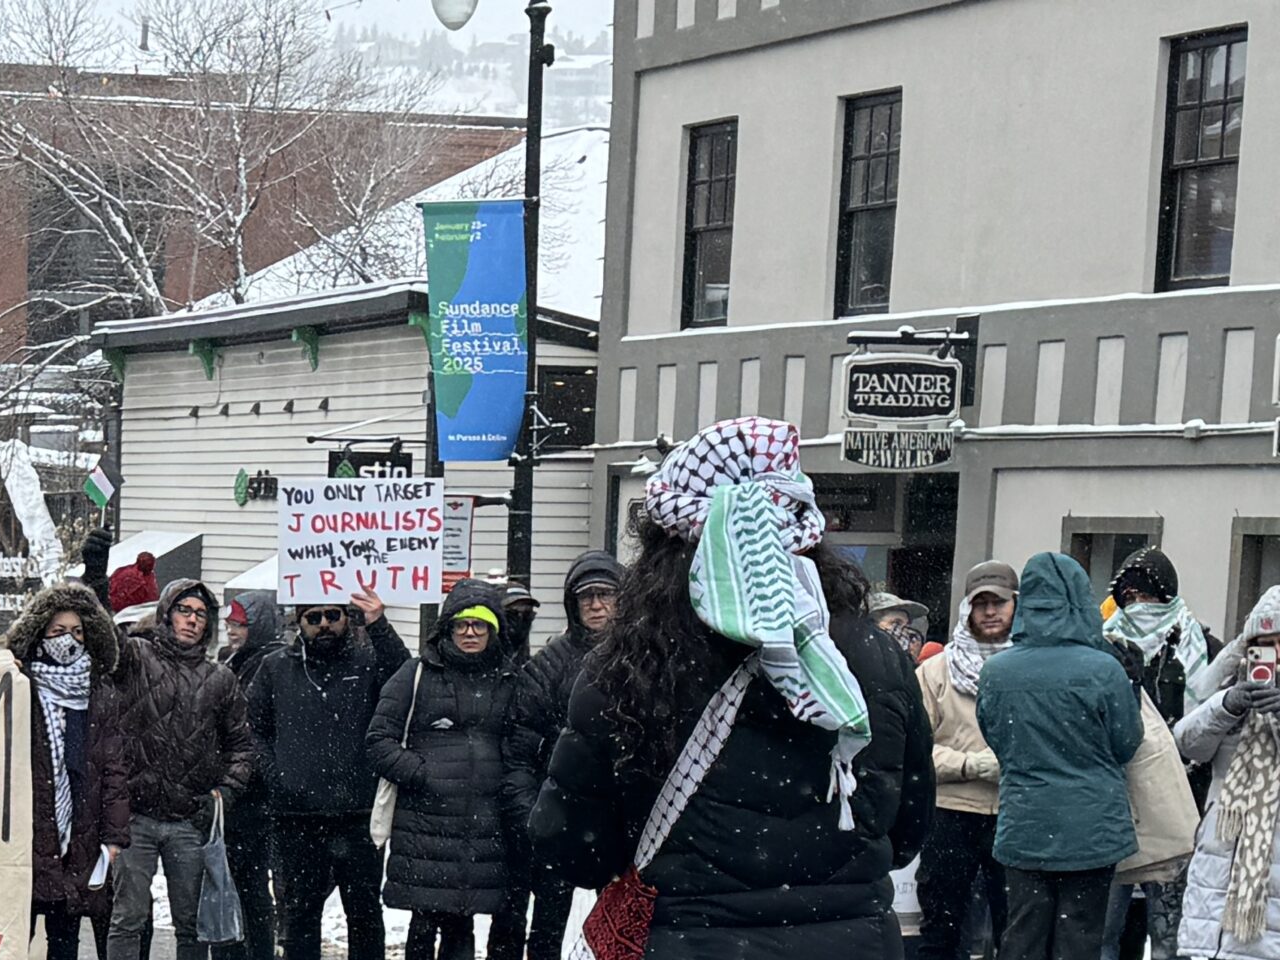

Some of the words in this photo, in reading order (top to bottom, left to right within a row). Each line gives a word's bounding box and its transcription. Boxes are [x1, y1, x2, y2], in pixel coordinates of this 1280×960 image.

[438, 300, 519, 315] Sundance
[441, 319, 482, 334] Film
[441, 337, 520, 352] Festival
[442, 356, 483, 372] 2025
[852, 373, 952, 394] TANNER
[854, 393, 951, 408] TRADING
[846, 432, 889, 451] NATIVE
[891, 432, 952, 451] AMERICAN
[858, 450, 936, 469] JEWELRY
[282, 487, 315, 506] YOU
[323, 484, 365, 502] ONLY
[375, 482, 435, 502] TARGET
[288, 507, 442, 533] JOURNALISTS
[287, 542, 334, 560] WHEN
[340, 539, 379, 560] YOUR
[386, 537, 439, 551] ENEMY
[330, 555, 346, 568] IS
[363, 553, 389, 566] THE
[283, 566, 429, 598] TRUTH
